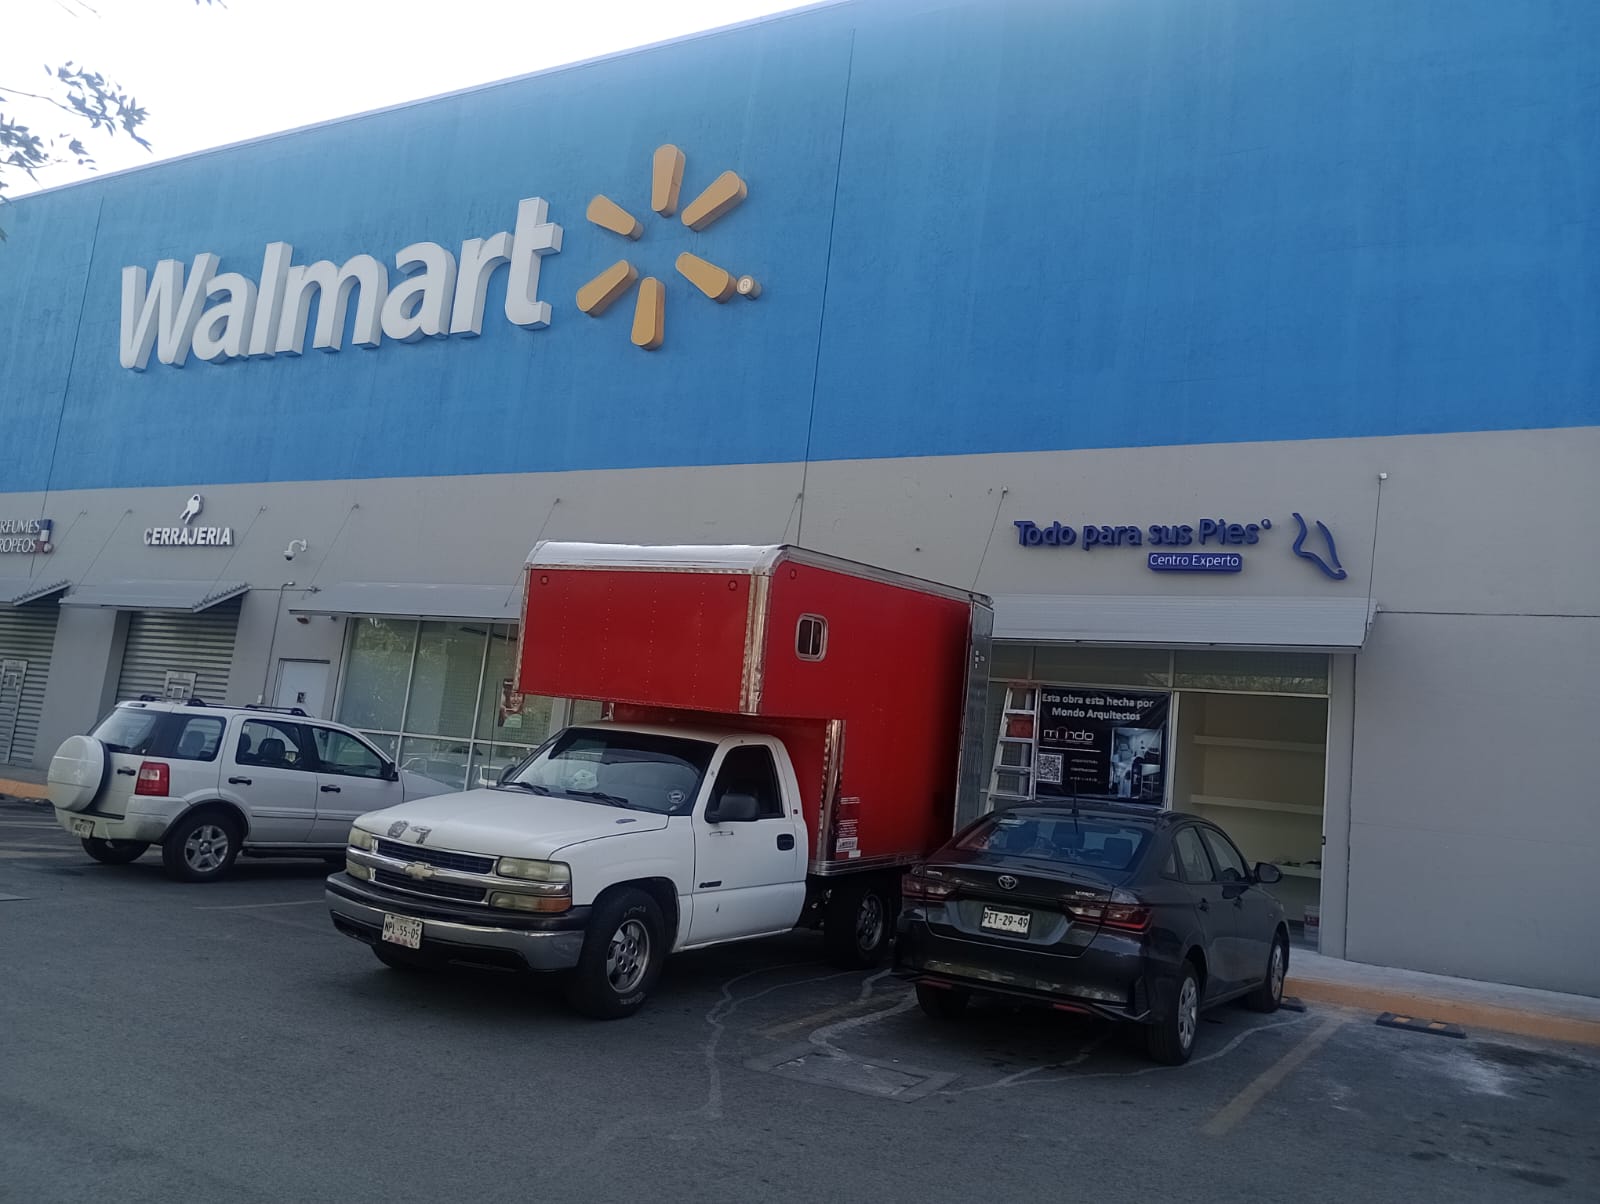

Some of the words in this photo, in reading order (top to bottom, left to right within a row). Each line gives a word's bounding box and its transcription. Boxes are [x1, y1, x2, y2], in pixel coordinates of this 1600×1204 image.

[119, 196, 564, 371] Walmart
[143, 526, 234, 547] CERRAJERIA
[1013, 520, 1077, 547] Todo
[1082, 521, 1143, 551] para
[1147, 520, 1194, 546] sus
[1199, 518, 1260, 546] Pies
[1149, 553, 1189, 567] Centro
[1192, 554, 1240, 569] Experto
[1042, 693, 1061, 703] Esta
[1063, 693, 1084, 704] obra
[1085, 696, 1105, 706] esta
[1106, 697, 1135, 708] hecha
[1136, 699, 1154, 710] por
[1051, 706, 1085, 719] Mondo
[1086, 708, 1141, 721] Arquitectos
[983, 911, 1029, 929] PET-29-49
